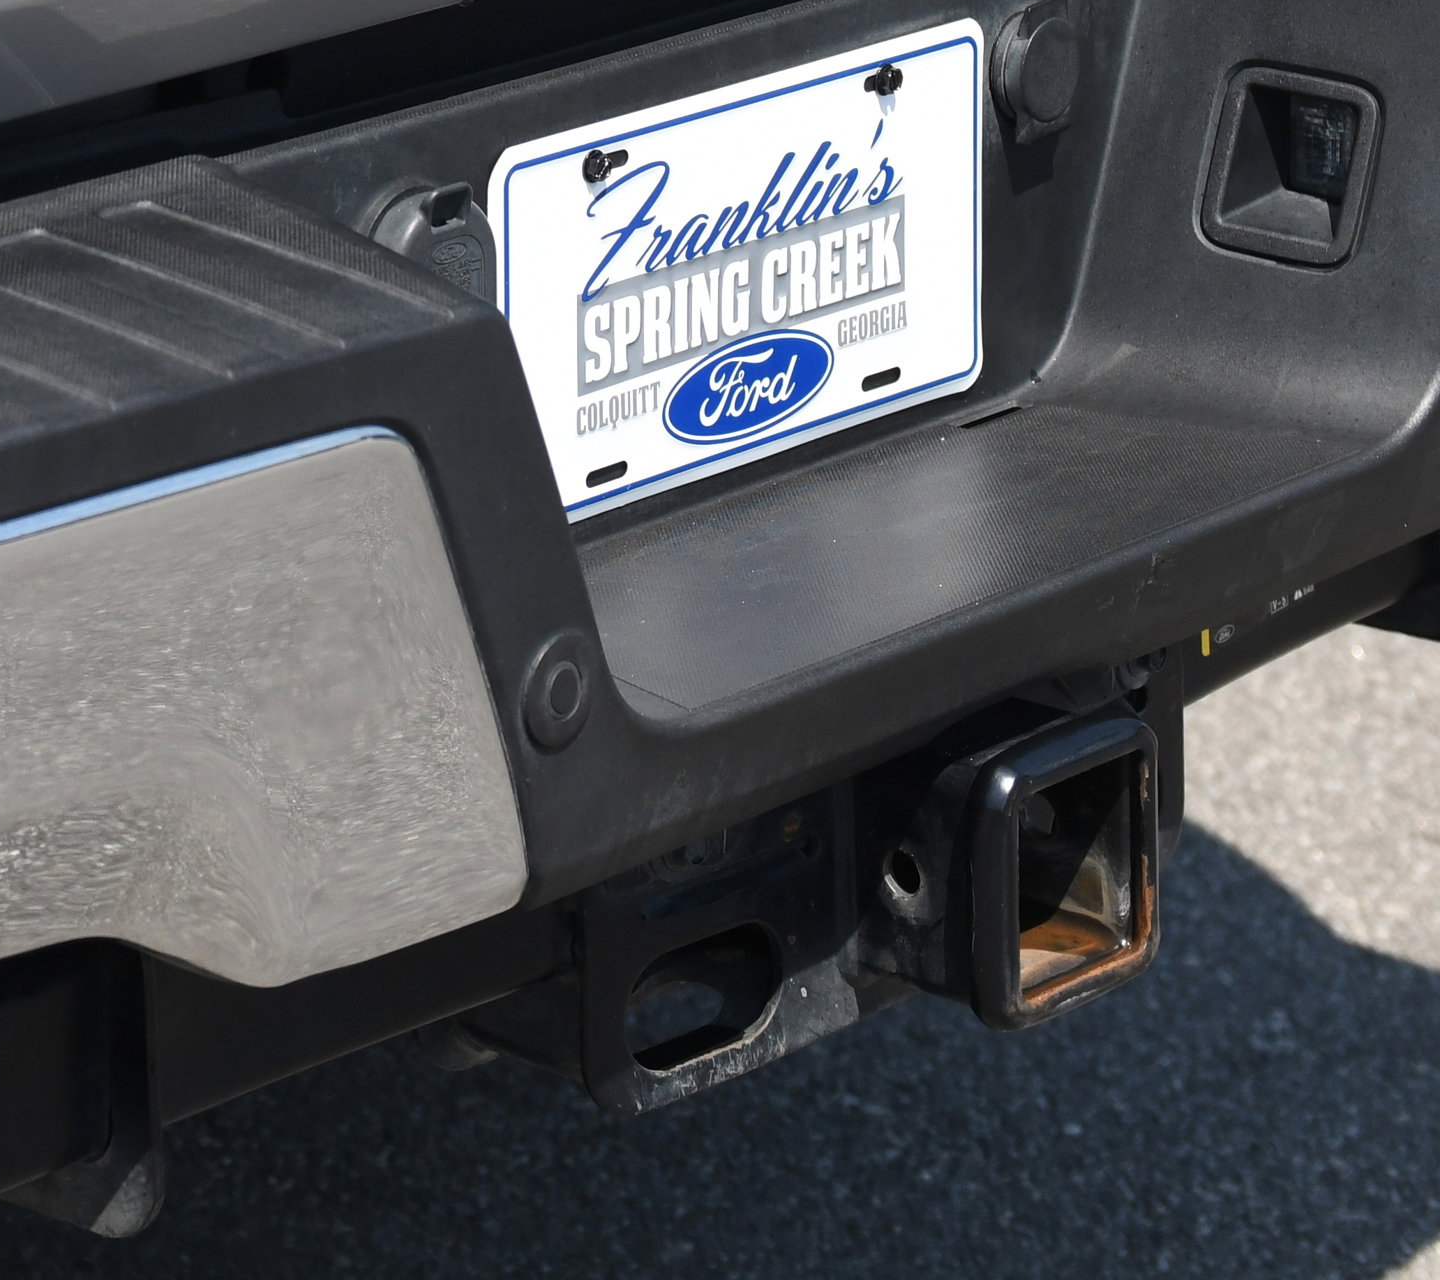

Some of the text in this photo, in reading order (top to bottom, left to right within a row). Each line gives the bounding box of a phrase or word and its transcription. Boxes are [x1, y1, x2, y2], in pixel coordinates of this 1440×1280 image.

[581, 118, 904, 303] Franklin's
[583, 212, 902, 383] SPRING CREEK
[837, 300, 908, 347] GEORGIA
[576, 381, 661, 436] COLQUITT
[698, 346, 799, 428] Ford
